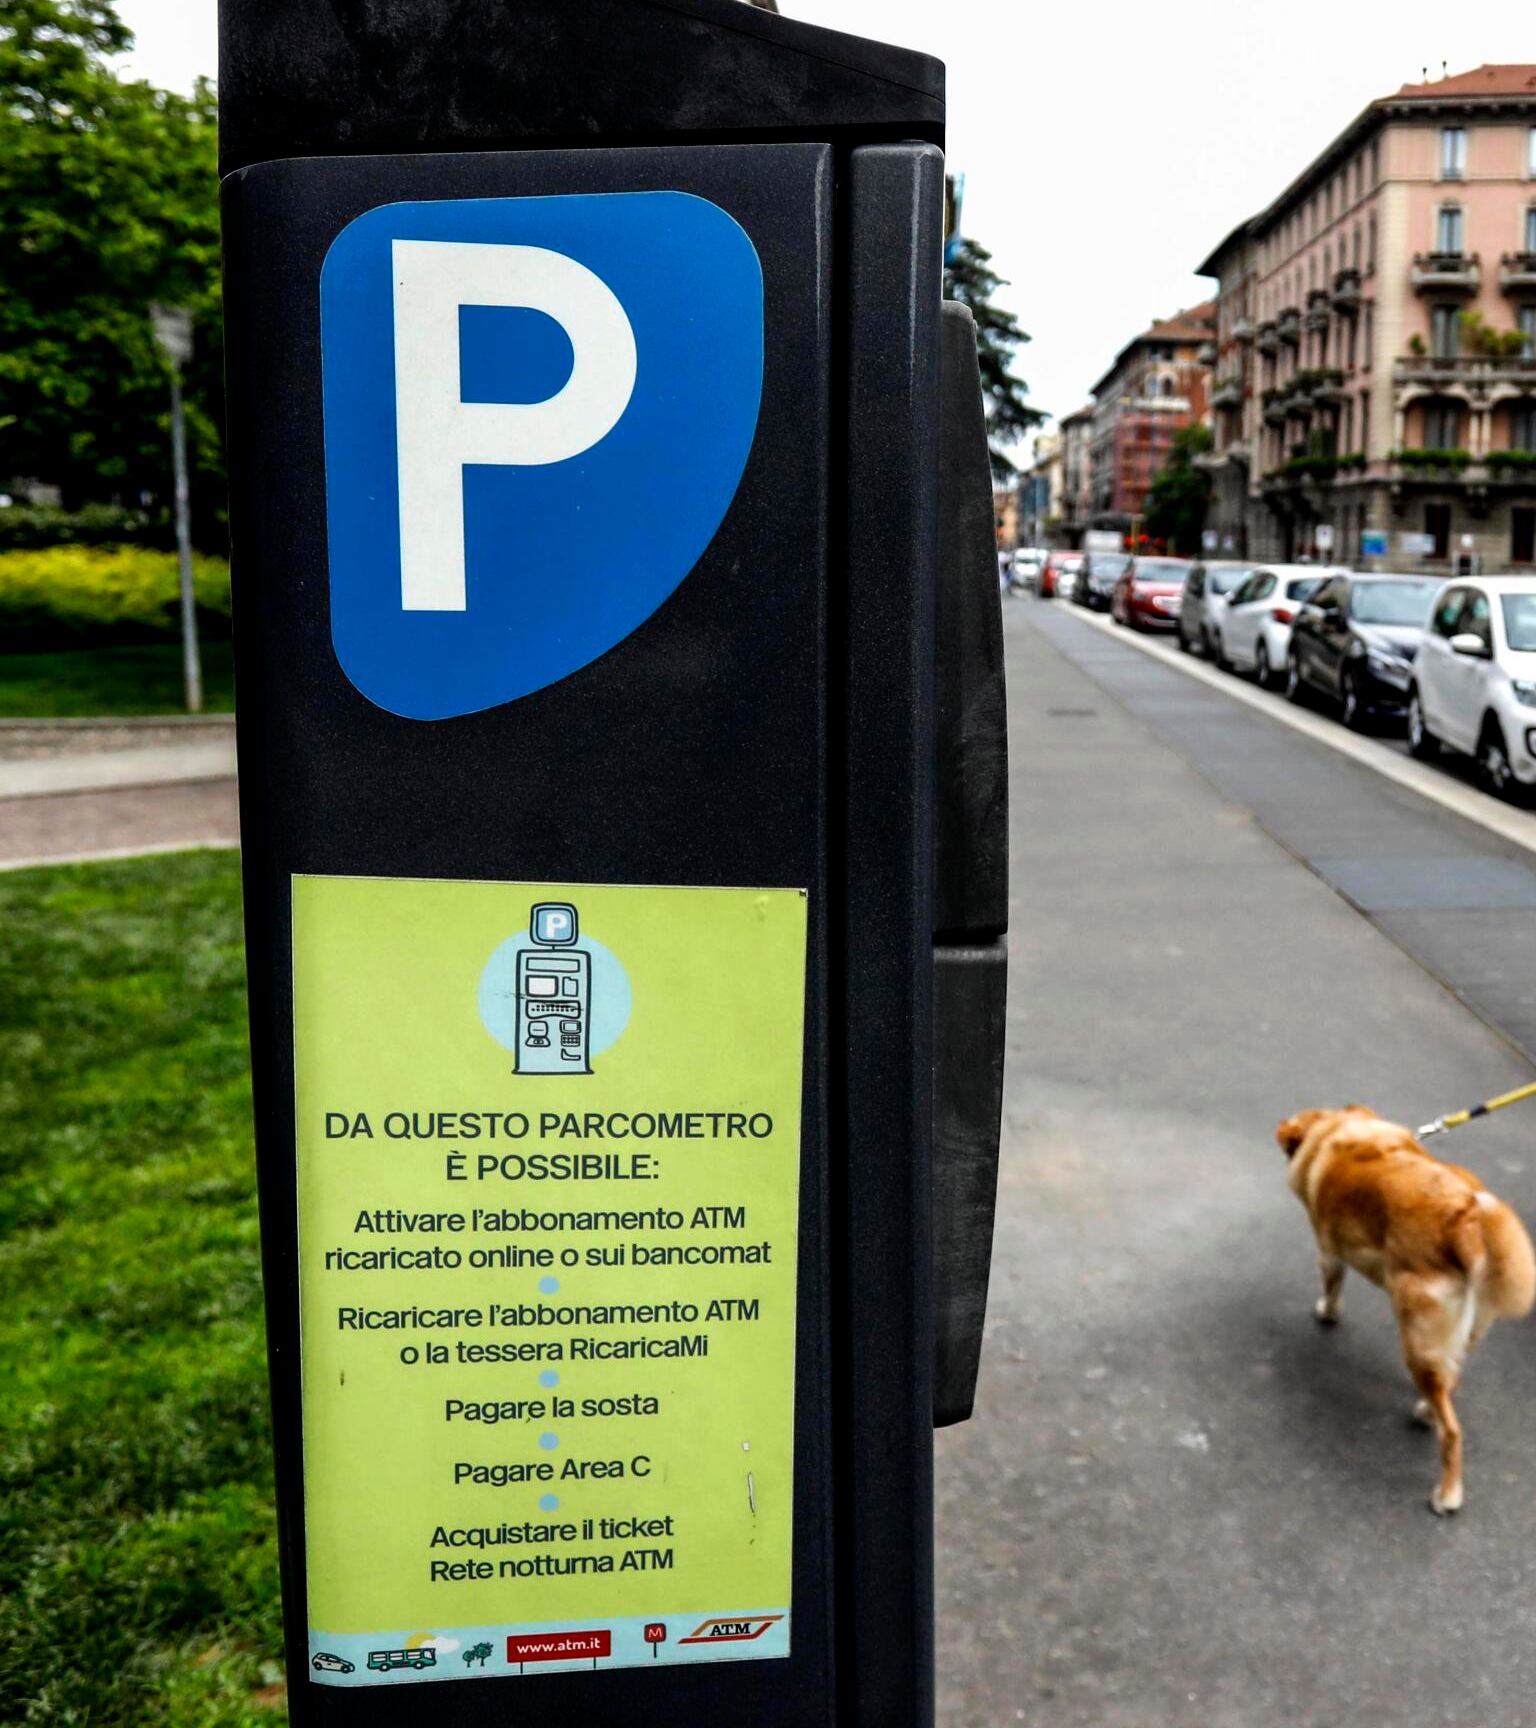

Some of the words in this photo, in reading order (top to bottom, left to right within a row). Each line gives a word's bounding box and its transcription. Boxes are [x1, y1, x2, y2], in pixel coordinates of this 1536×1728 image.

[391, 239, 637, 611] P
[545, 912, 568, 938] P
[325, 1112, 374, 1139] DA
[383, 1112, 530, 1140] QUESTO
[539, 1112, 773, 1139] PARCOMETRO
[446, 1150, 468, 1181] È
[477, 1154, 659, 1181] POSSIBILE:
[353, 1209, 466, 1233] Attivare
[689, 1206, 745, 1229] ATM
[325, 1246, 463, 1271] ricaricato
[468, 1245, 555, 1269] online
[560, 1248, 579, 1267] o
[585, 1243, 625, 1267] sui
[631, 1241, 772, 1266] bancomat
[338, 1306, 483, 1330] Ricaricare
[704, 1298, 760, 1322] ATM
[399, 1346, 420, 1365] o
[426, 1341, 449, 1364] la
[455, 1340, 564, 1364] tessera
[570, 1334, 708, 1360] RicaricaMi
[445, 1399, 546, 1425] Pagare
[552, 1396, 575, 1418] la
[581, 1393, 659, 1417] sosta
[454, 1462, 555, 1488] Pagare
[559, 1458, 625, 1481] Area
[630, 1455, 651, 1478] C
[429, 1521, 578, 1550] Acquistare
[582, 1518, 594, 1541] il
[598, 1515, 675, 1540] ticket
[430, 1558, 495, 1583] Rete
[499, 1554, 615, 1579] notturna
[618, 1548, 674, 1572] ATM
[648, 1627, 664, 1638] M
[709, 1621, 752, 1638] ATM
[516, 1636, 602, 1655] www.atm.it
